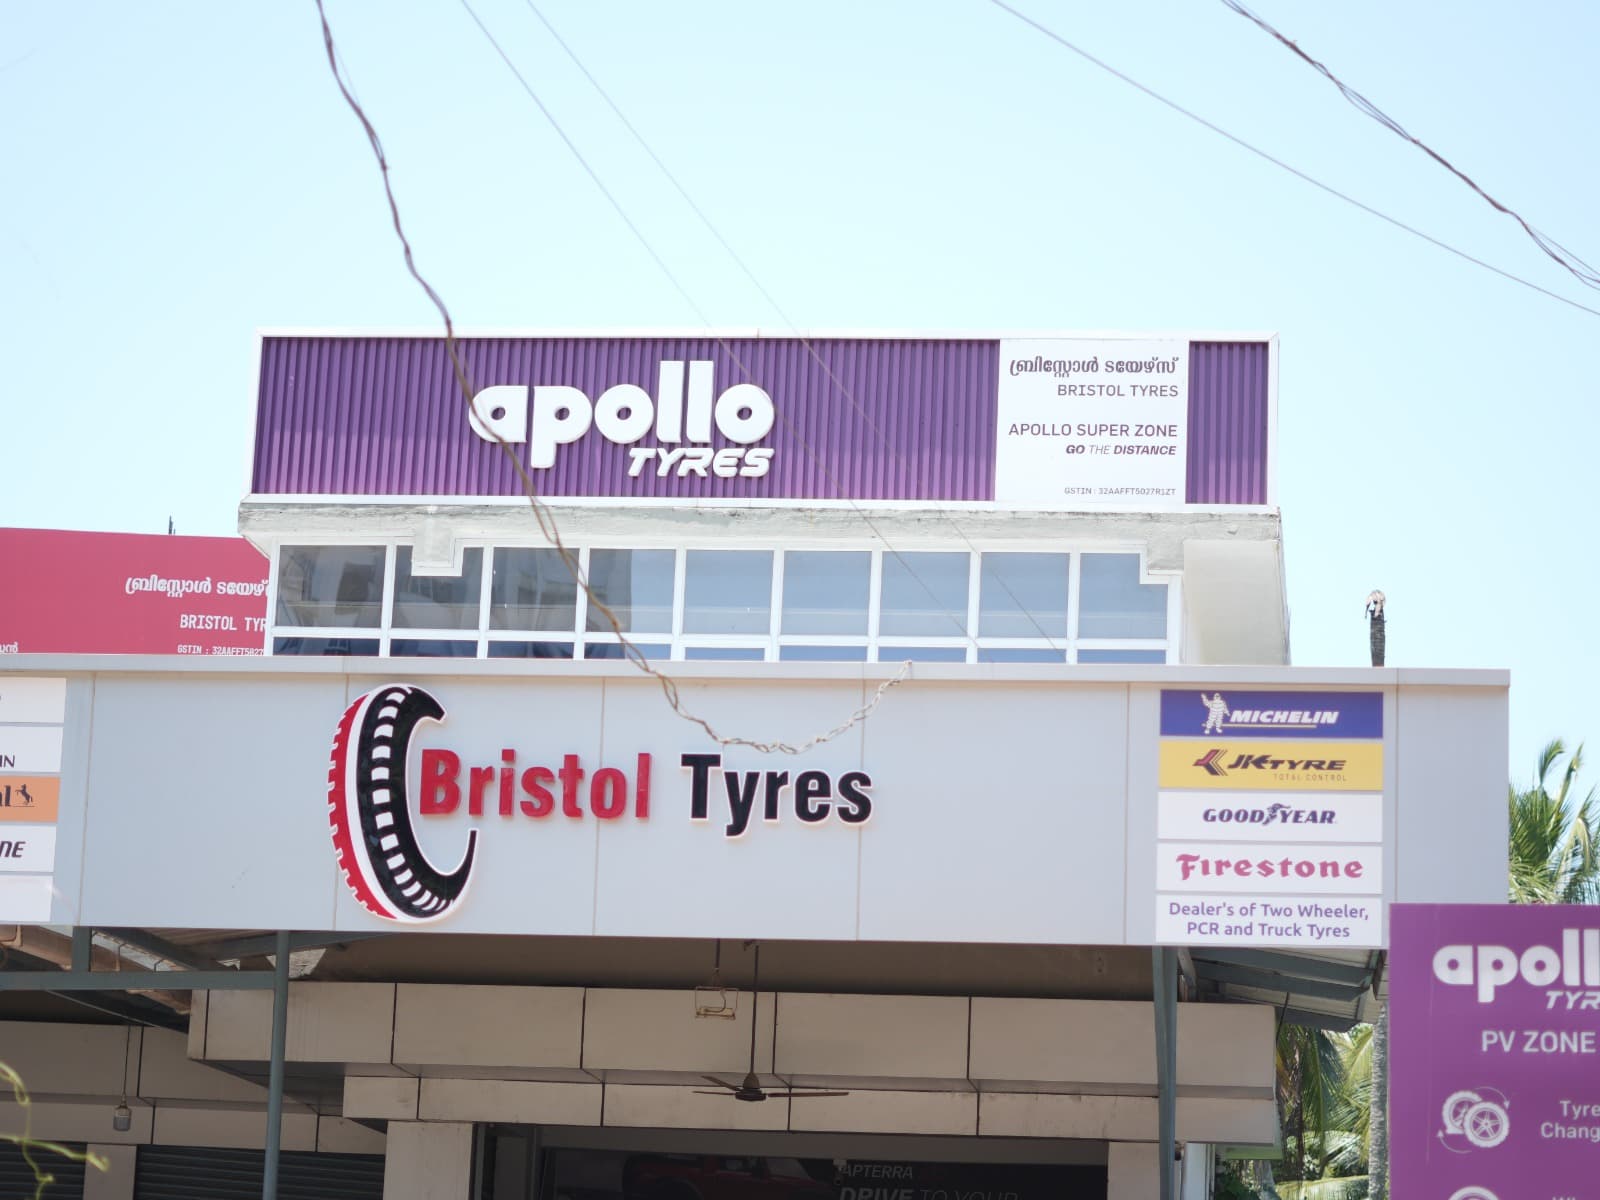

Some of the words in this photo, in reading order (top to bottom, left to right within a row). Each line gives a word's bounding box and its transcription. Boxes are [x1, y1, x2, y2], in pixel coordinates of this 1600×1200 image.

[1057, 384, 1125, 397] BRISTOL
[1130, 385, 1179, 397] TYRES
[469, 360, 775, 468] apollo
[1008, 423, 1072, 436] APOLLO
[1076, 424, 1130, 437] SUPER
[1134, 424, 1178, 437] ZONE
[1066, 444, 1086, 455] GO
[1090, 445, 1112, 455] THE
[1113, 445, 1177, 456] DISTANCE
[628, 447, 775, 478] TYRES
[1064, 487, 1092, 495] GSTIN
[180, 614, 237, 631] BRISTOL
[177, 645, 202, 654] GSTIN
[1230, 710, 1339, 724] MICHELIN
[1306, 774, 1347, 782] CONTROL
[419, 749, 651, 819] Bristol
[681, 752, 873, 838] Tyres
[1176, 853, 1364, 881] Firestone
[1169, 902, 1235, 917] Dealer's
[1239, 903, 1257, 917] of
[1261, 904, 1293, 918] Two
[1298, 904, 1369, 921] Wheeler,
[1187, 922, 1219, 935] PCR
[1224, 922, 1254, 936] and
[1258, 923, 1303, 937] Truck
[1307, 924, 1351, 940] Tyres
[1481, 1030, 1516, 1053] PV
[1522, 1031, 1597, 1054] ZONE
